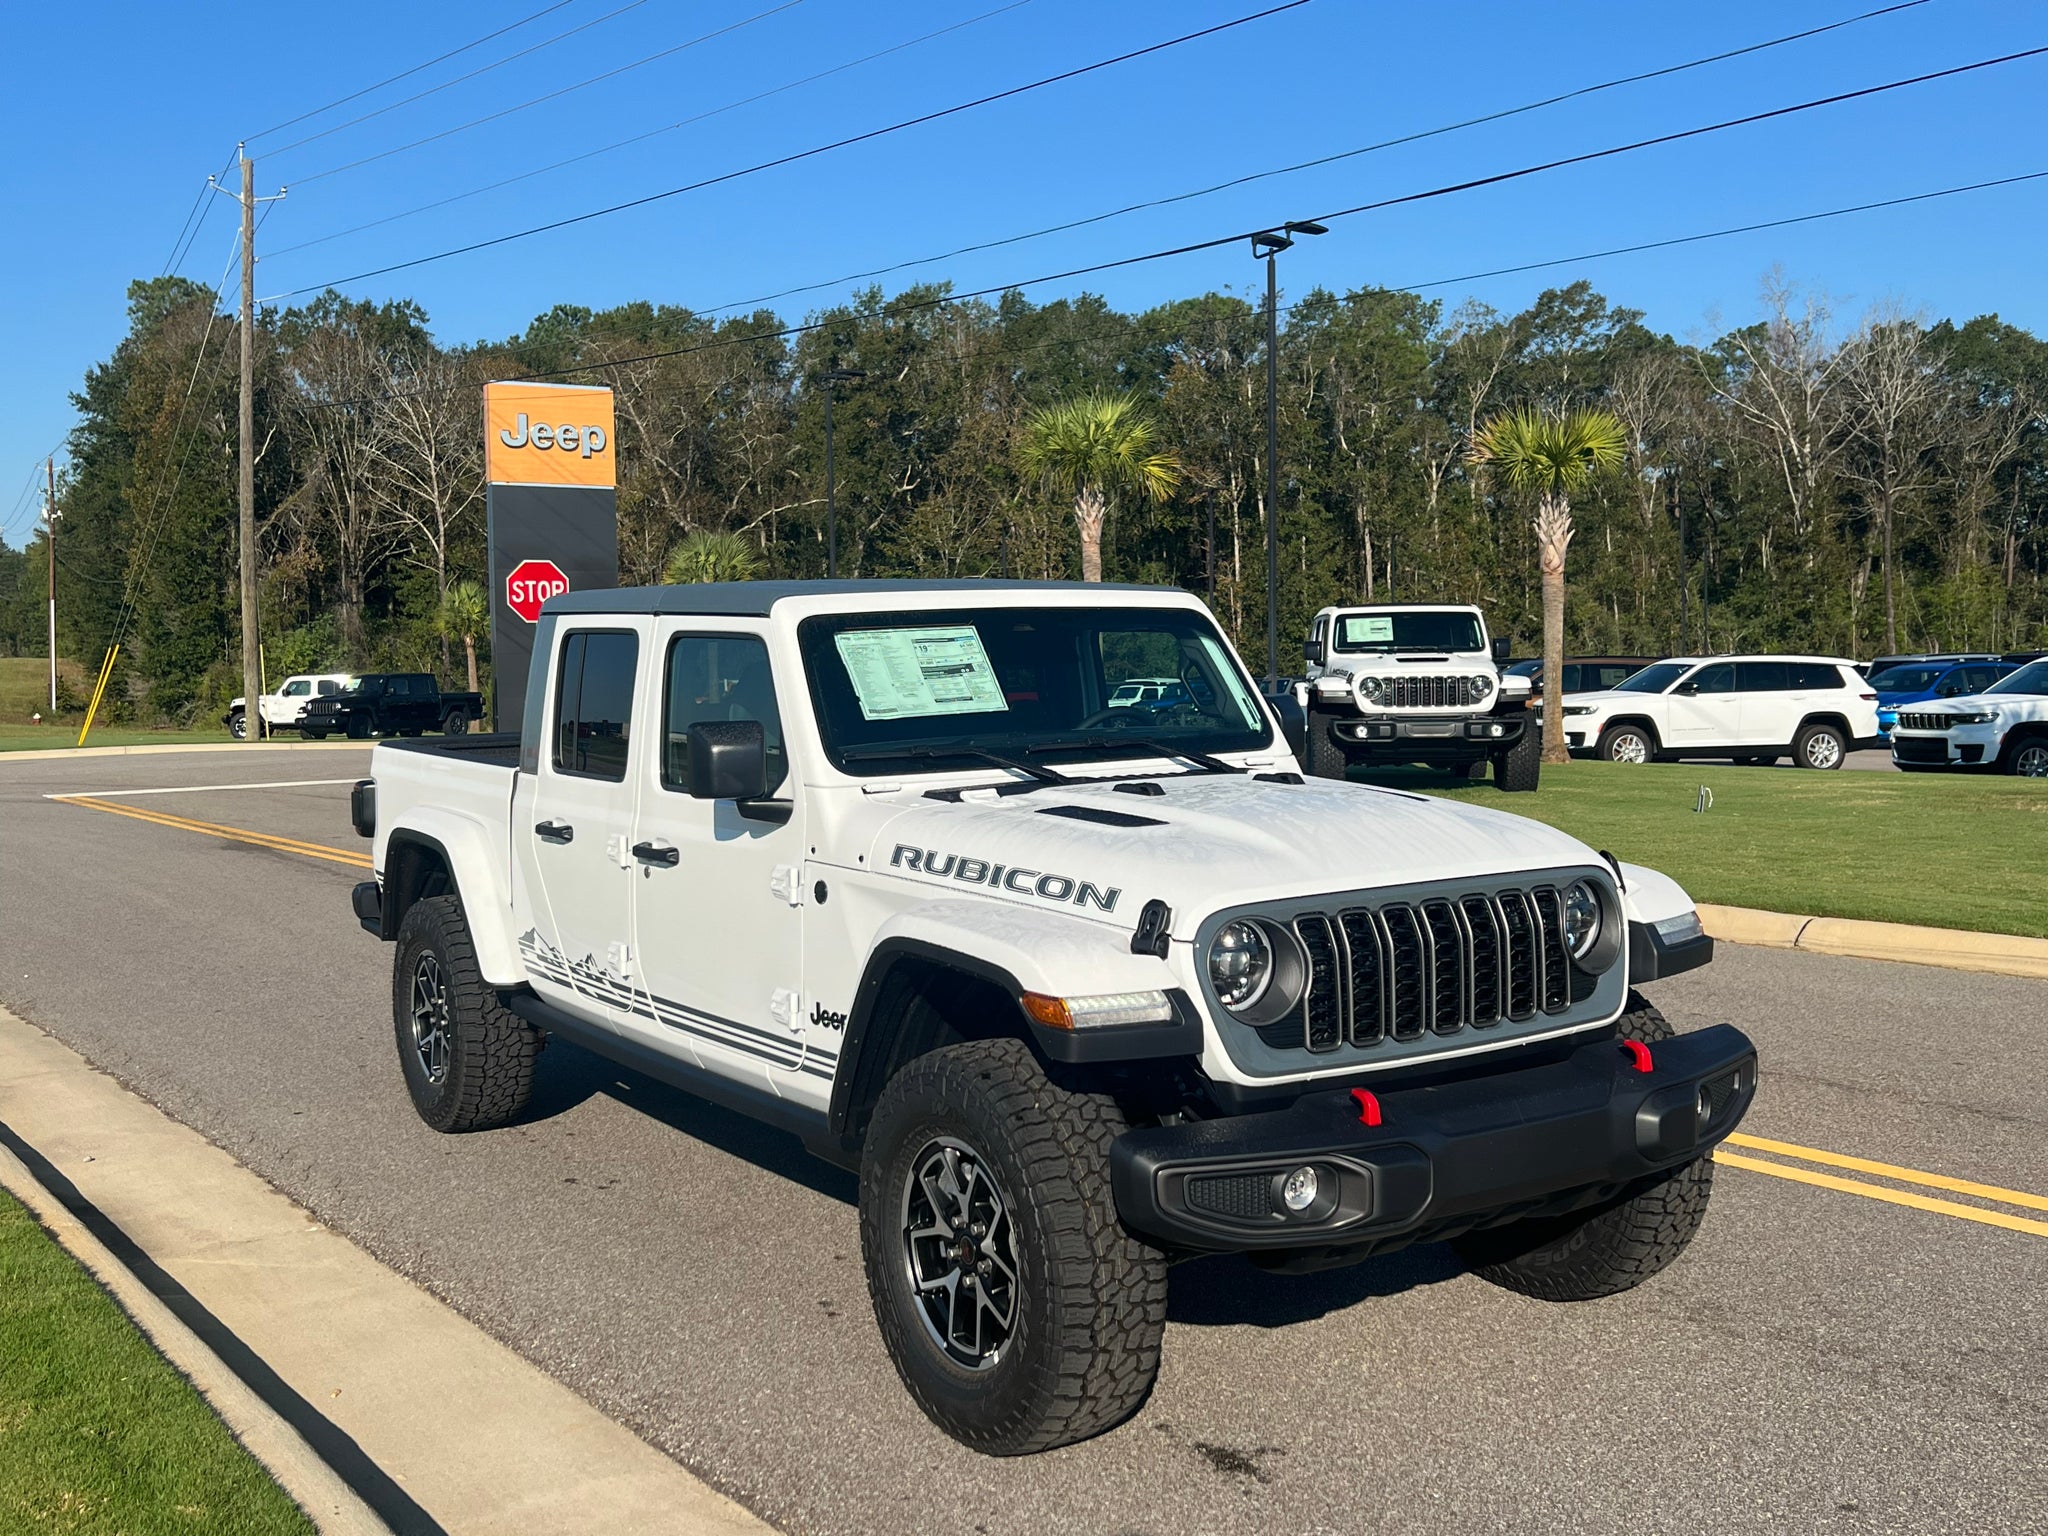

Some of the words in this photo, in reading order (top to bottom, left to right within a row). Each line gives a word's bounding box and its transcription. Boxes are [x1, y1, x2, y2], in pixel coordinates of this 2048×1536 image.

[500, 413, 606, 459] Jeep
[511, 580, 565, 603] STOP
[890, 843, 1122, 913] RUBICON
